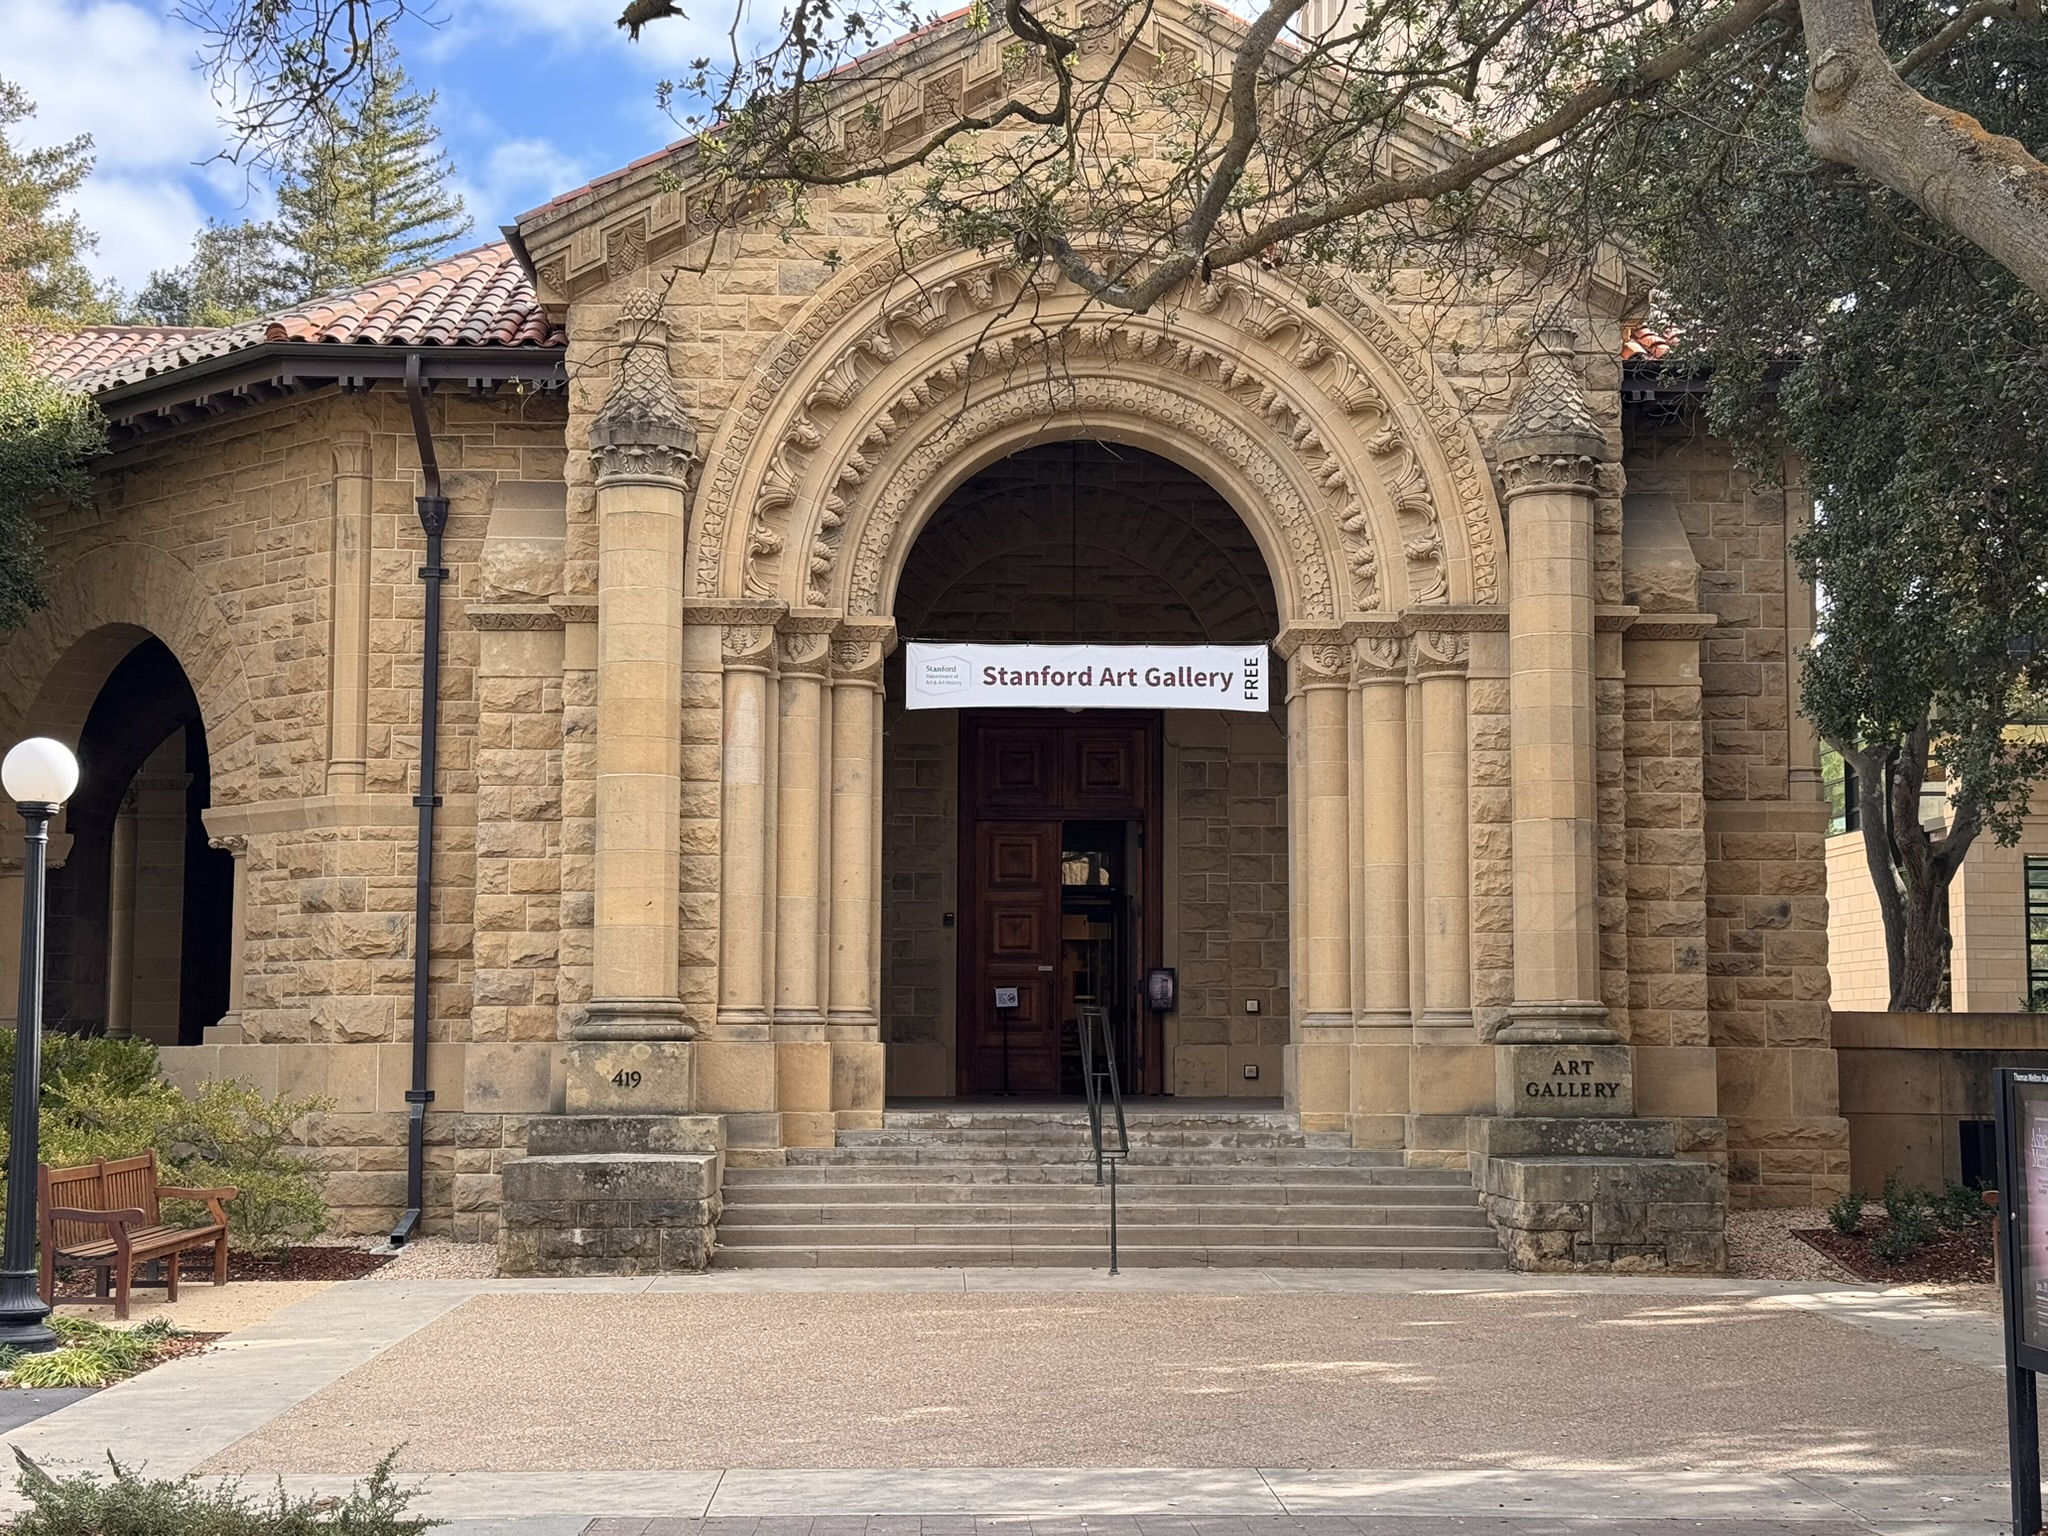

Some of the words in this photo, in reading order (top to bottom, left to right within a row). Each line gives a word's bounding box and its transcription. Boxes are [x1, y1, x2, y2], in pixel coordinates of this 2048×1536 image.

[926, 664, 956, 672] Stanford
[982, 665, 1092, 687] Stanford
[1099, 667, 1138, 687] Art
[1144, 666, 1234, 693] Gallery
[1244, 657, 1259, 700] FREE
[1552, 1060, 1594, 1075] ART
[611, 1068, 642, 1089] 419
[1525, 1081, 1621, 1098] GALLERY
